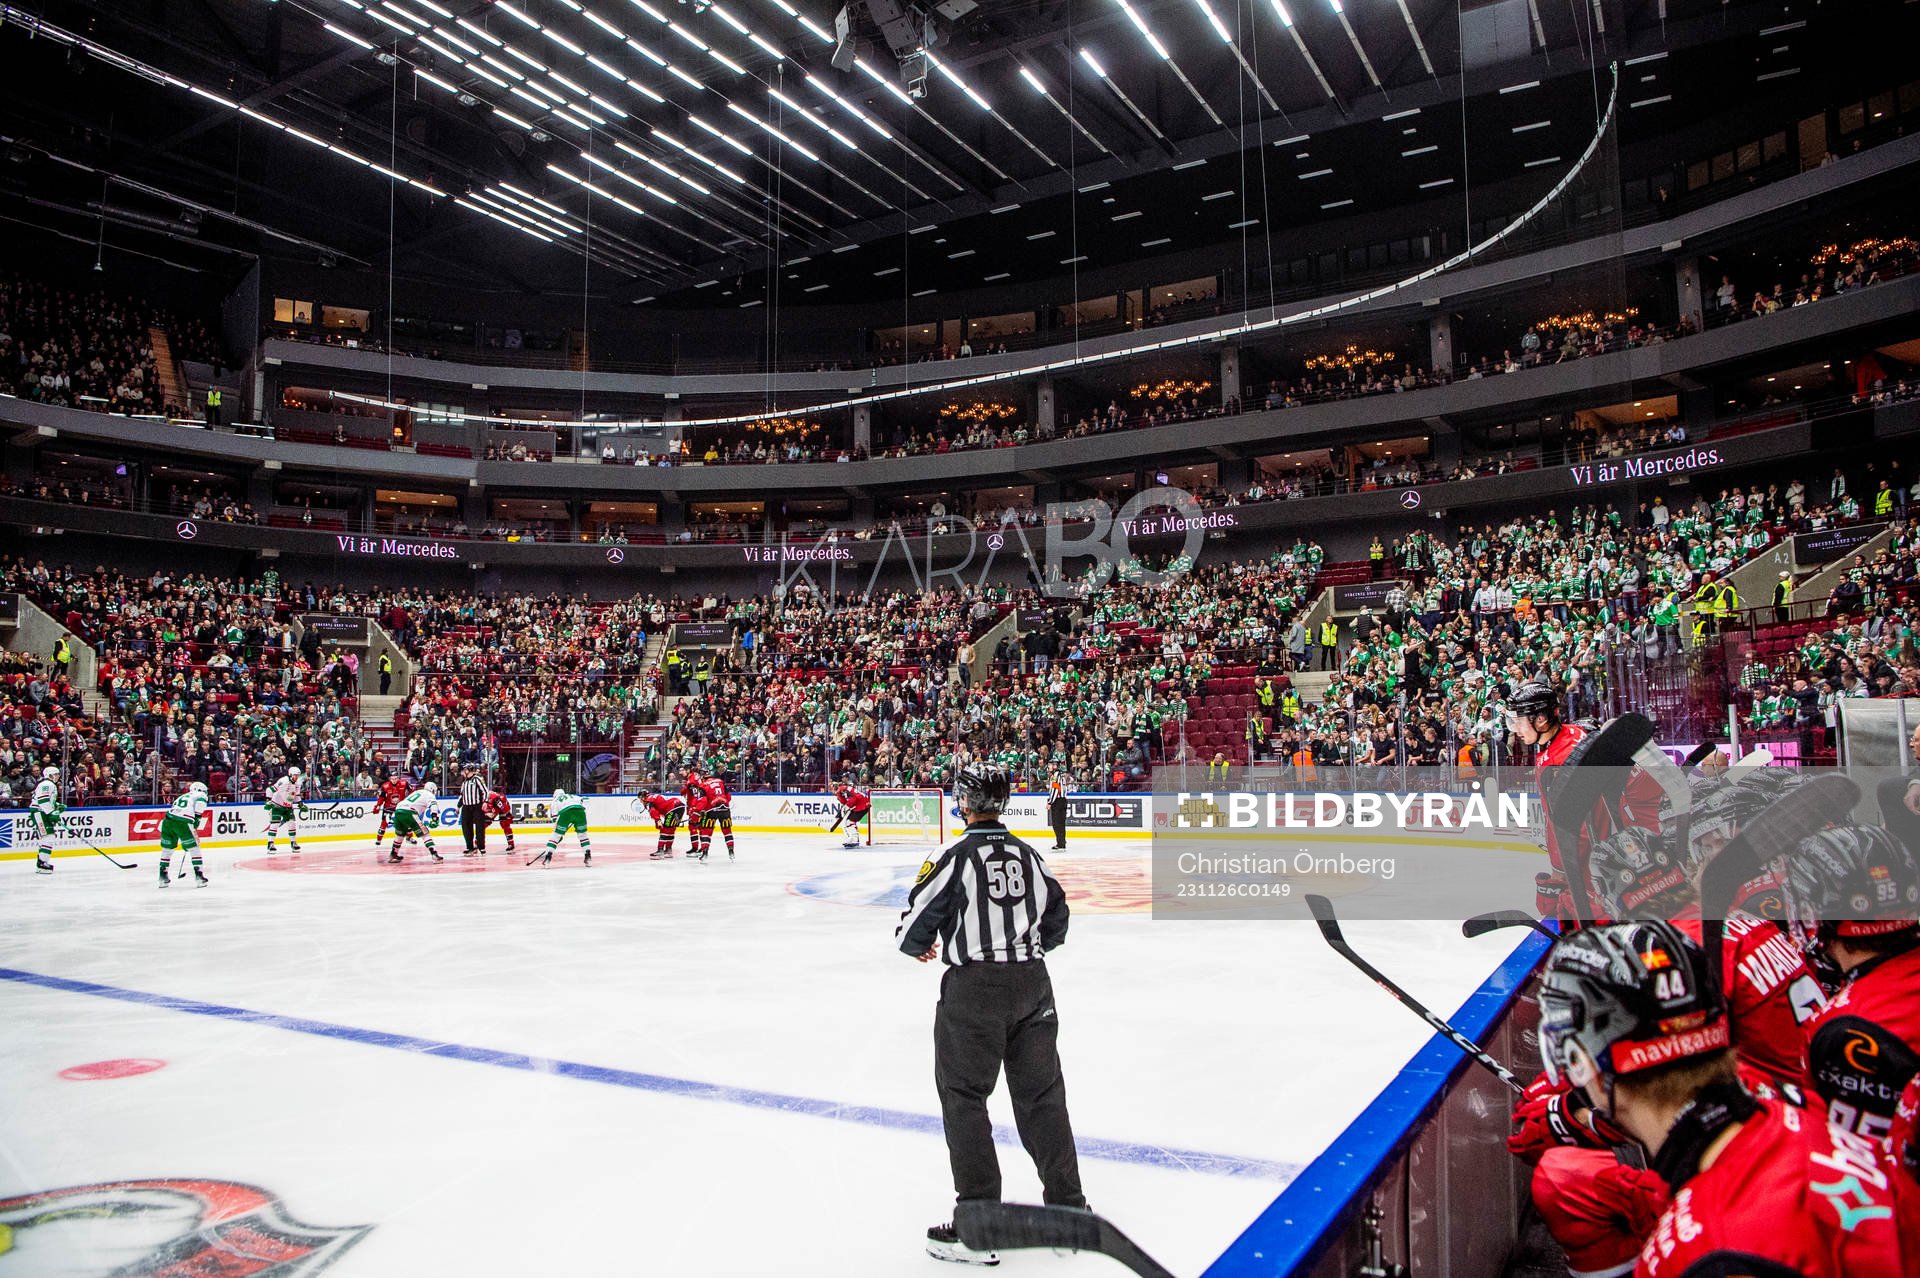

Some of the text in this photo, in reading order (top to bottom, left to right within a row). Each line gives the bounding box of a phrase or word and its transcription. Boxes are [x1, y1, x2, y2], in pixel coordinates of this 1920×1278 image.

[1570, 448, 1725, 486] Vi är Mercedes.
[1121, 511, 1239, 537] Vi är Mercedes.
[337, 535, 460, 558] Vi är Mercedes.
[743, 546, 854, 562] Vi är Mercedes.
[217, 823, 247, 834] OUT.
[218, 811, 242, 822] ALL
[95, 827, 112, 838] AB
[985, 859, 1026, 899] 58
[1630, 872, 1679, 903] navigator
[1655, 968, 1686, 1000] 44
[1630, 1029, 1728, 1065] navigator
